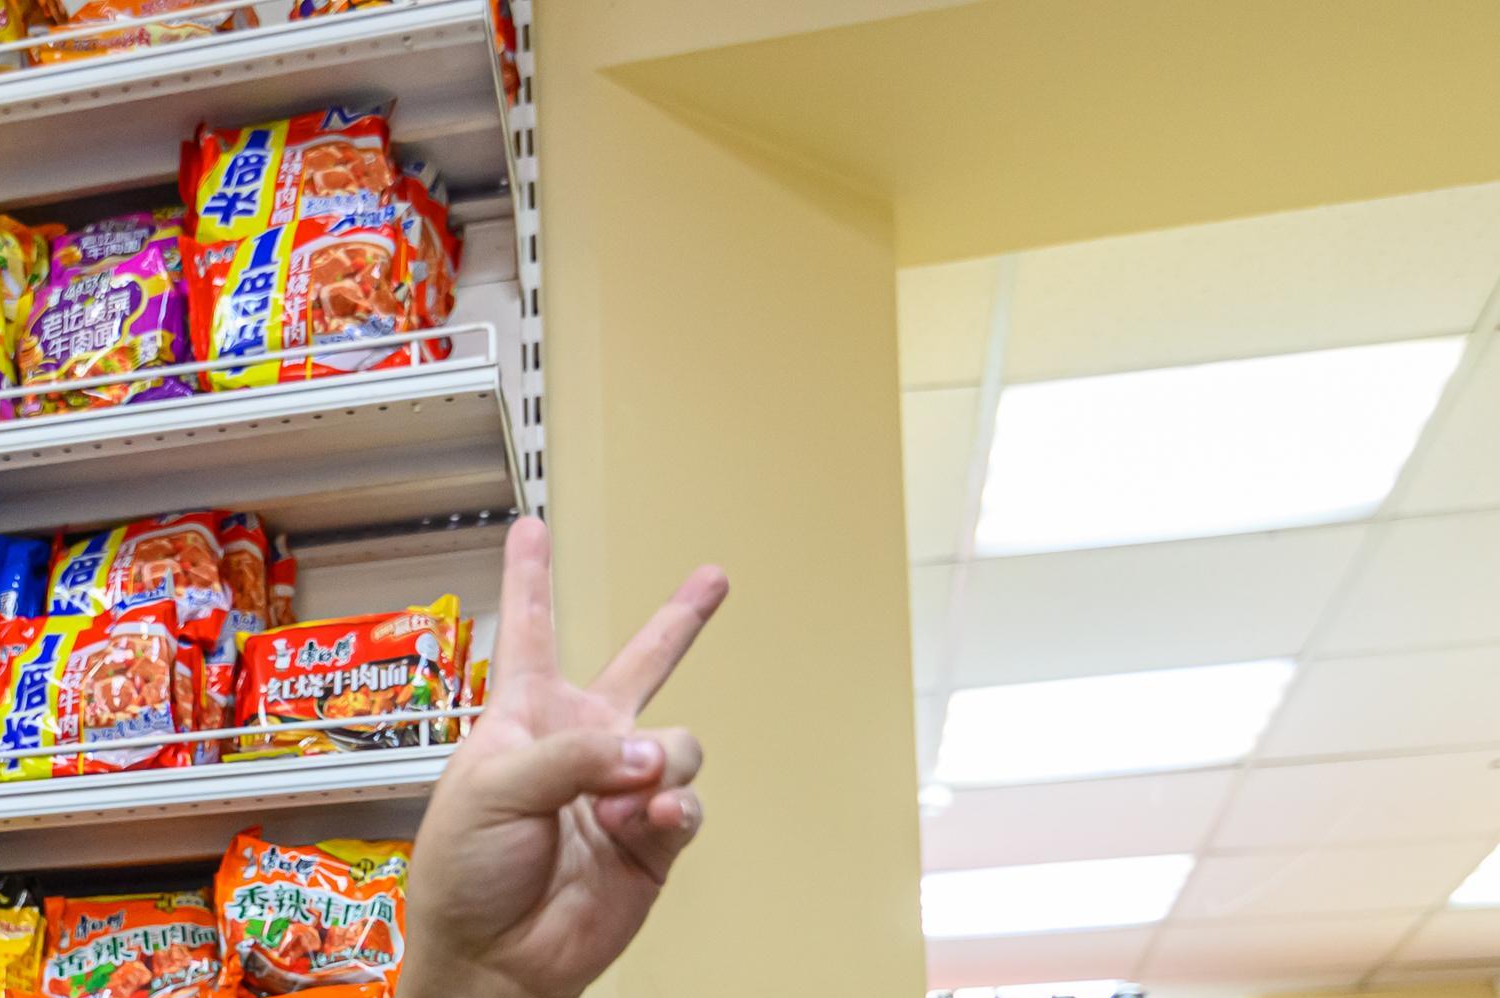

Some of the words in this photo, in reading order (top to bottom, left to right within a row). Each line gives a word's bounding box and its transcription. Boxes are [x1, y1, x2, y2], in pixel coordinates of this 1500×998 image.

[267, 662, 408, 702] 红烧牛肉面
[230, 885, 393, 925] 香辣牛肉面
